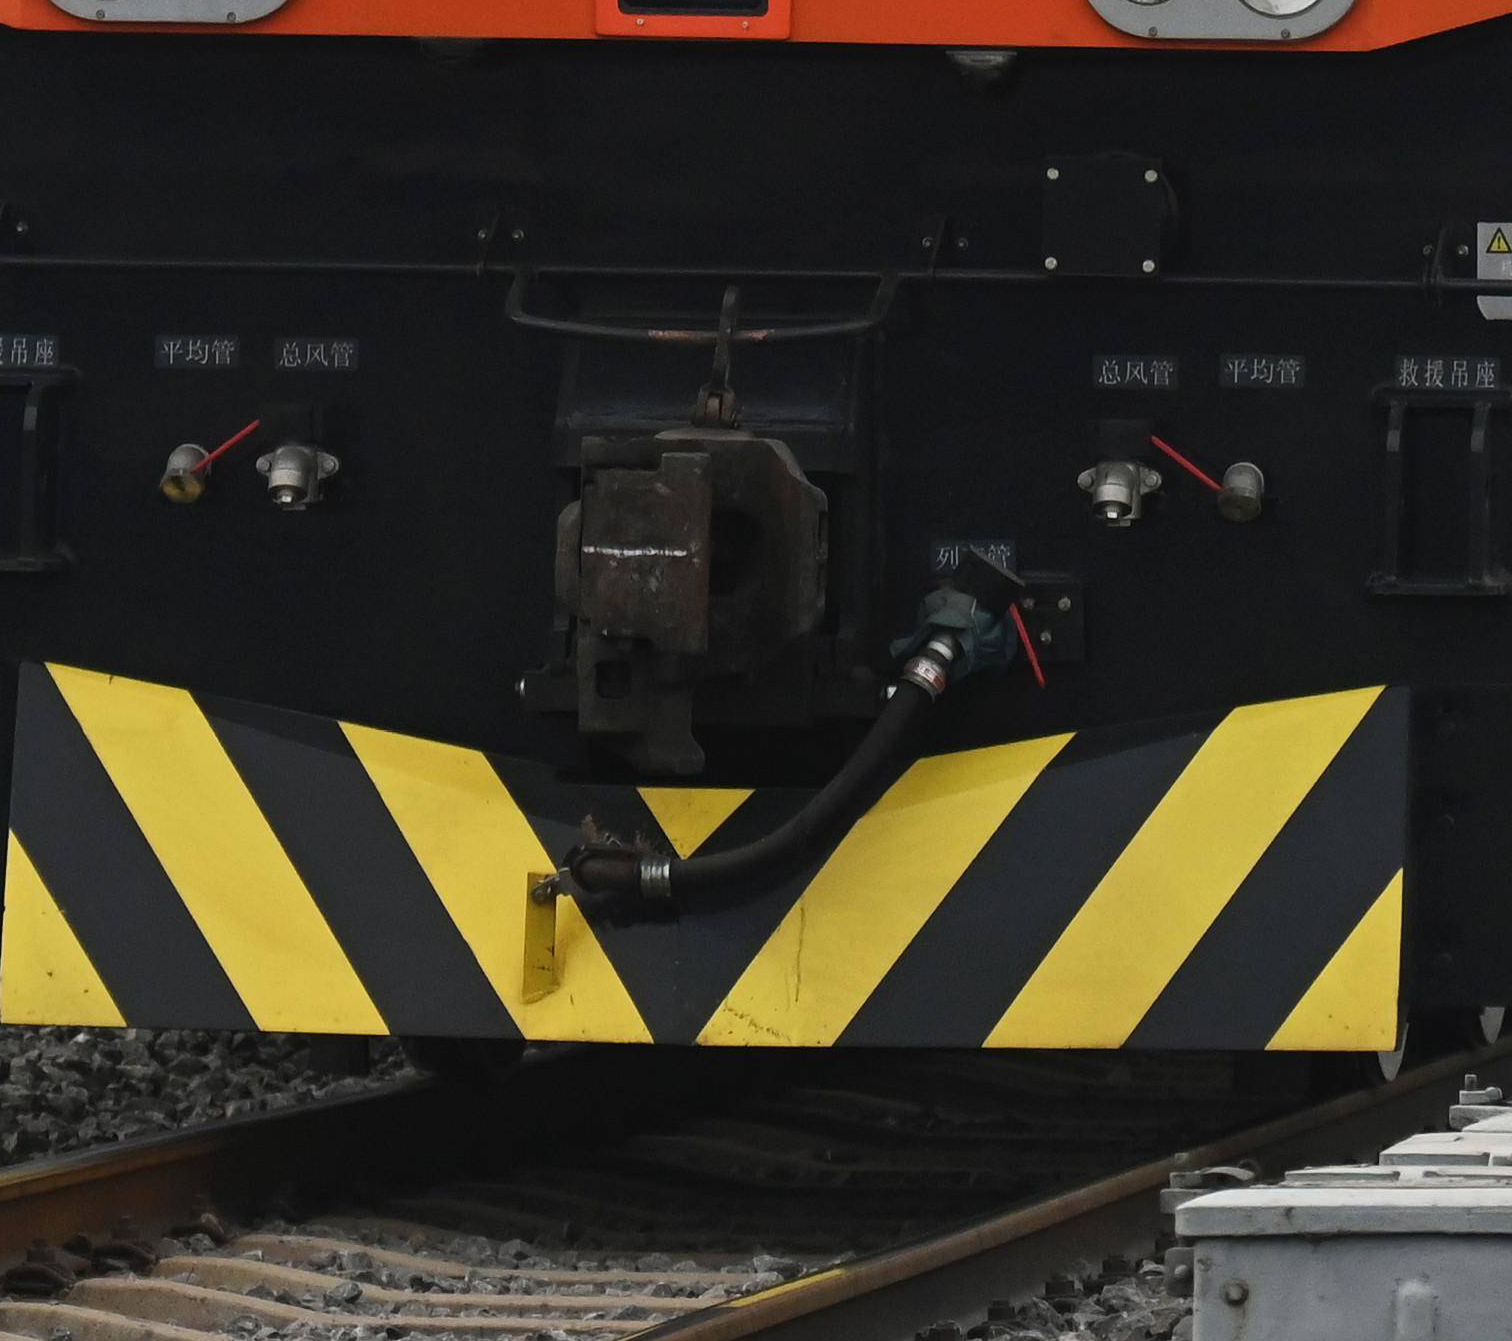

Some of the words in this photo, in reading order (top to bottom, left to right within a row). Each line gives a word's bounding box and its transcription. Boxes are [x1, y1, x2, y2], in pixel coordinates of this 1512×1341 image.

[161, 338, 236, 366] 平均管
[278, 340, 355, 369] 总风管
[1097, 358, 1175, 387] 总风管
[1223, 357, 1301, 385] 平均管
[1398, 358, 1496, 390] 救援吊座
